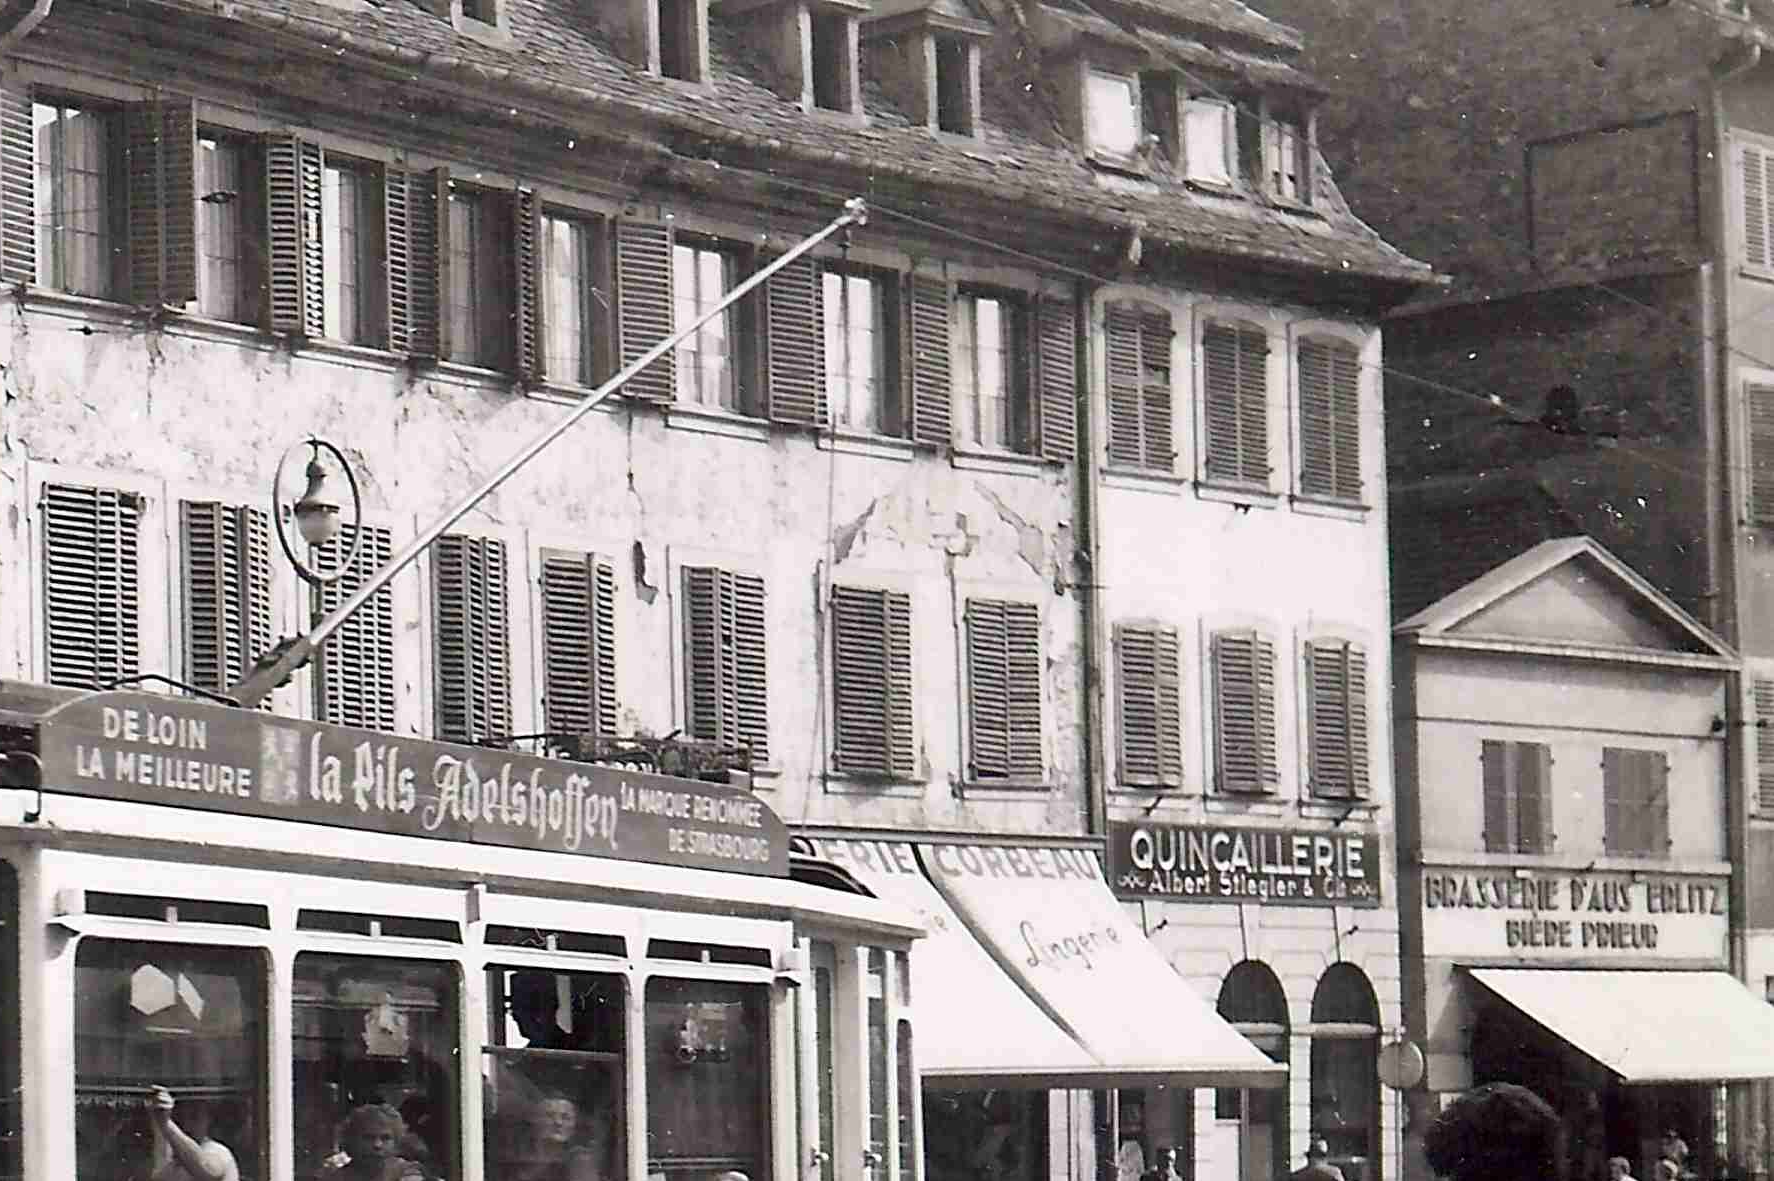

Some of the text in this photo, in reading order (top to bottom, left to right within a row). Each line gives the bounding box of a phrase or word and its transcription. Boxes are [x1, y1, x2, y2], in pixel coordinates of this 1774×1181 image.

[102, 706, 208, 751] DE LOIN
[76, 744, 253, 798] LA MEILLEURE
[309, 731, 620, 851] la Pils Adelshoffen
[620, 780, 636, 812] LA
[637, 788, 692, 820] MARQUE
[668, 827, 770, 864] DE STRASBOURG
[931, 843, 1097, 881] CORBEAU
[1130, 827, 1365, 879] QUINCAILLERIE
[1148, 869, 1211, 895] Albert
[1303, 877, 1314, 897] &
[1425, 874, 1560, 911] BRASSERIE
[1581, 920, 1659, 949] PRIEUR
